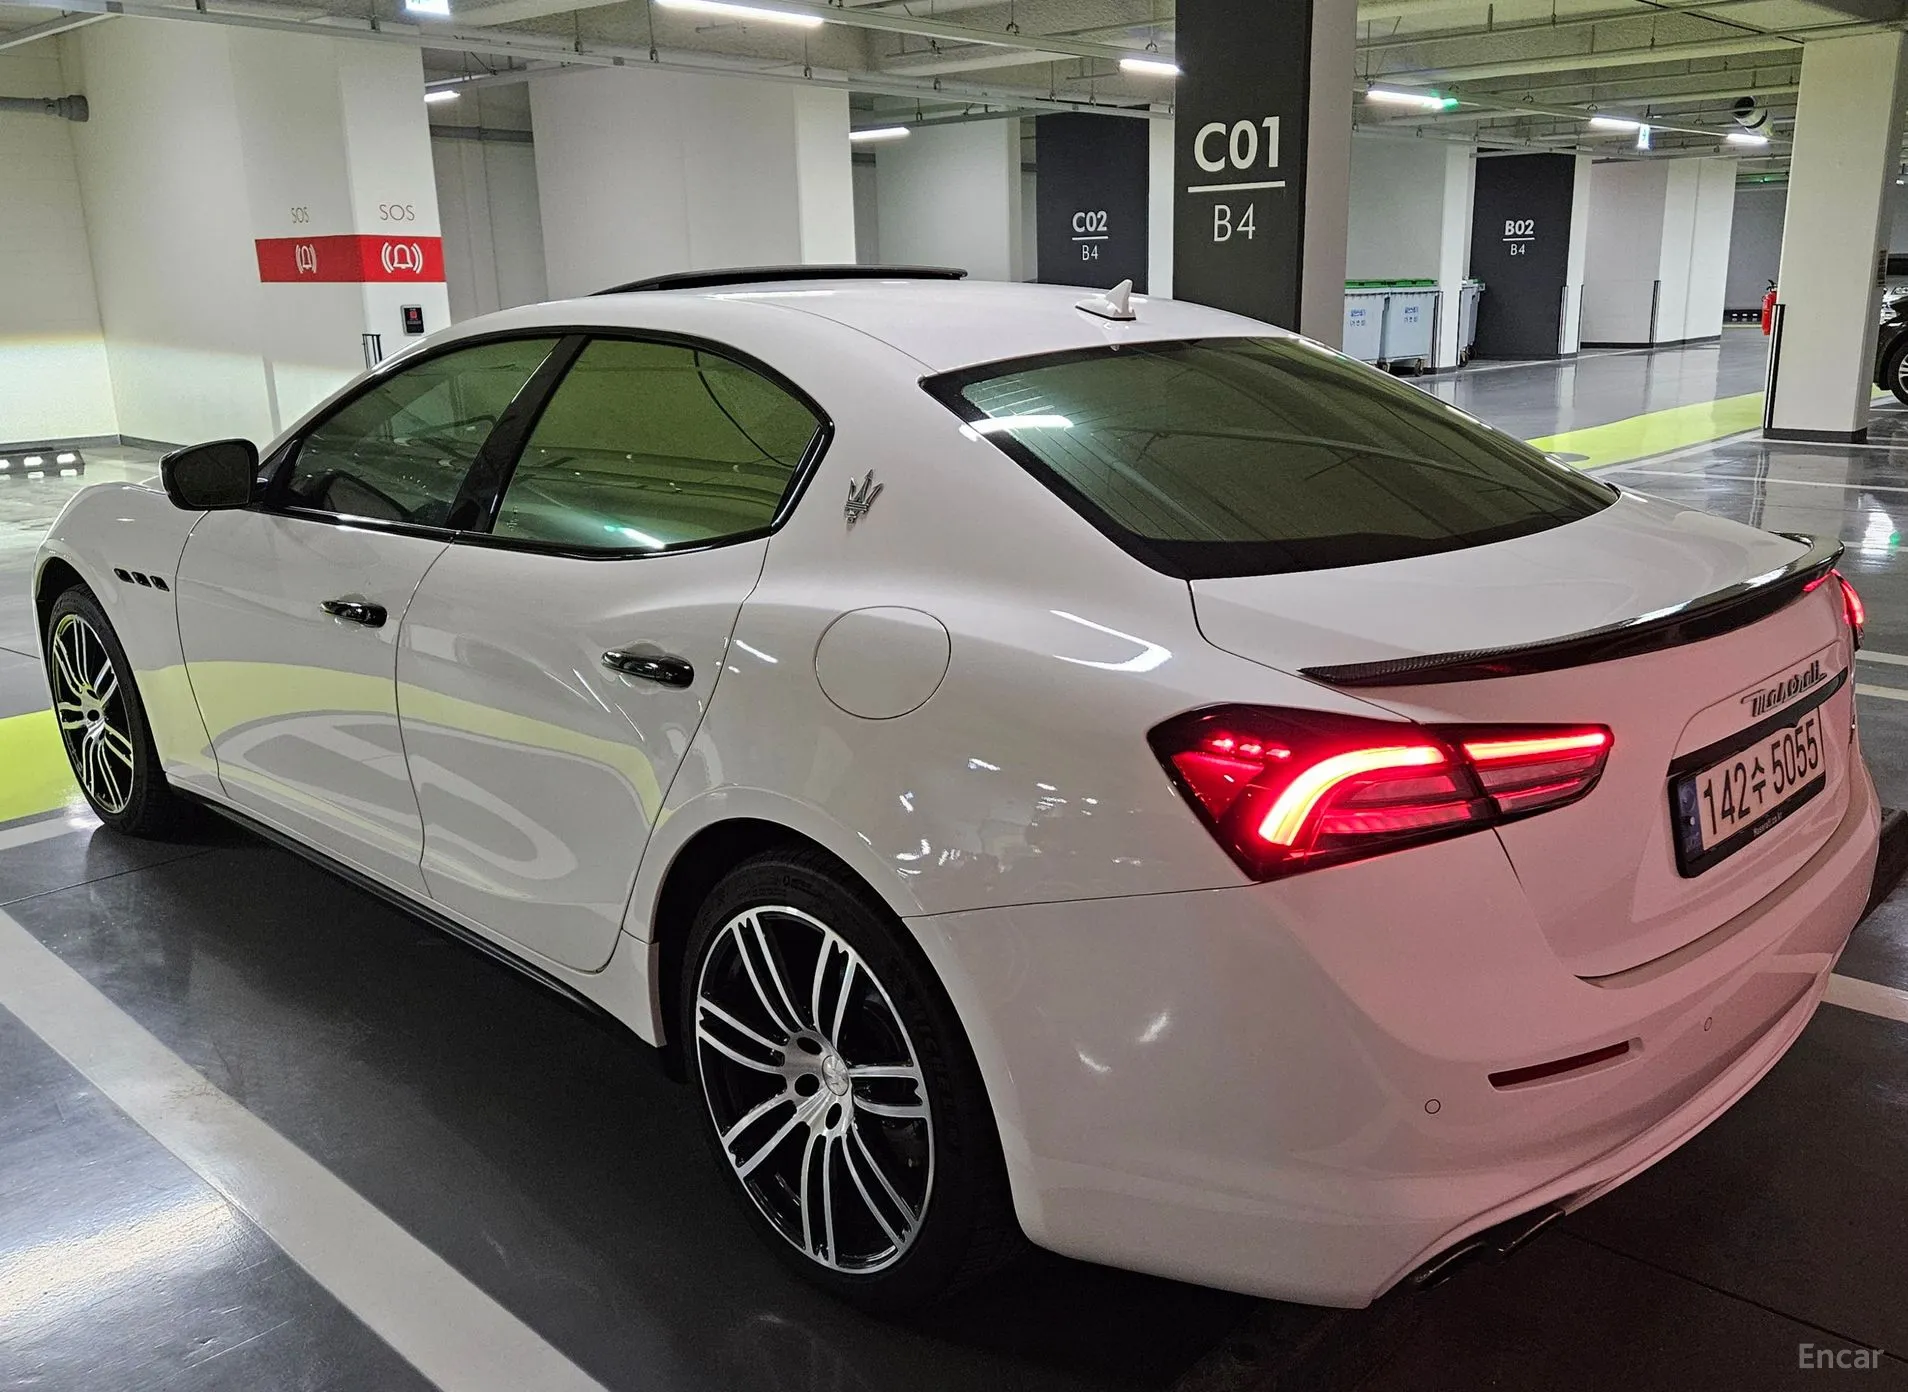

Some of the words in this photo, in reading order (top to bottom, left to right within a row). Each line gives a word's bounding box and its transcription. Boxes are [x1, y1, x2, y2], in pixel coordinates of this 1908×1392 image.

[1194, 115, 1281, 173] C01
[290, 206, 309, 224] SOS
[379, 203, 415, 221] SOS
[1072, 210, 1108, 233] C02
[1213, 202, 1257, 242] B4
[1503, 218, 1535, 236] B02
[1081, 244, 1099, 261] B4
[1510, 243, 1525, 256] B4
